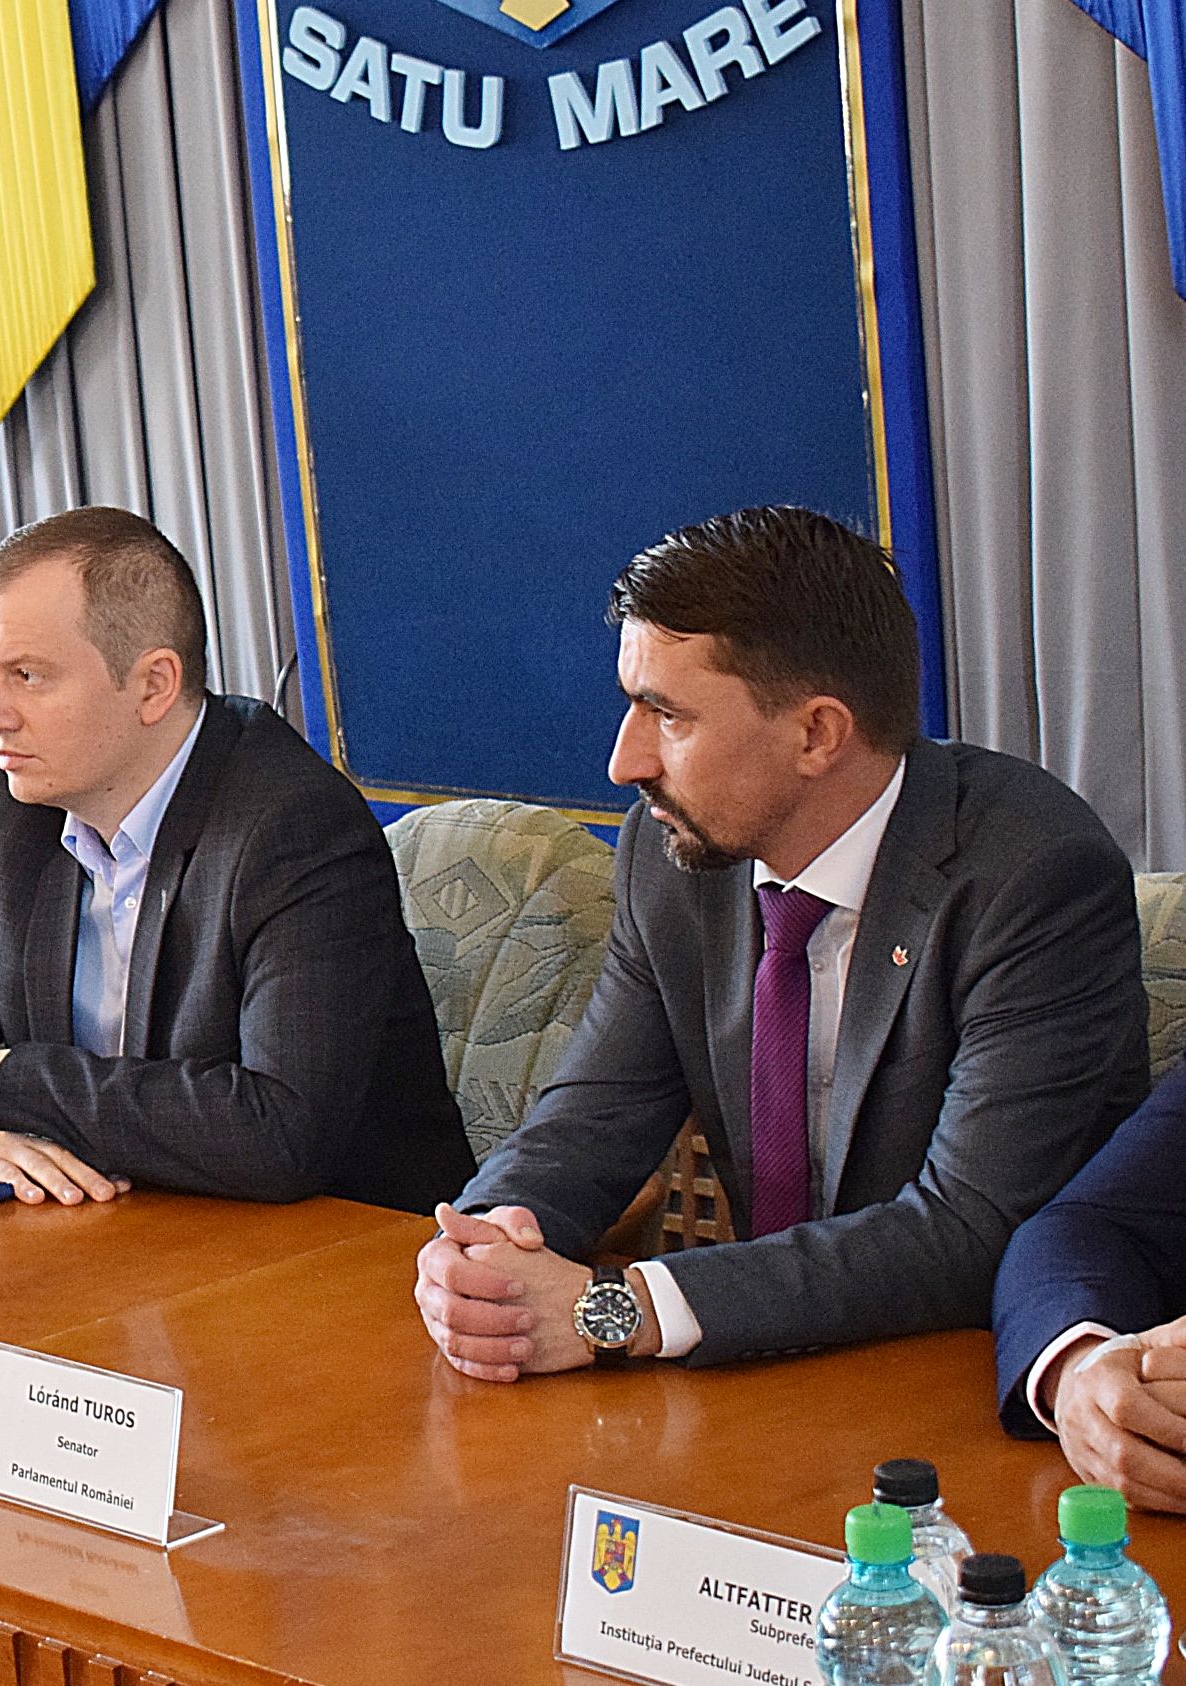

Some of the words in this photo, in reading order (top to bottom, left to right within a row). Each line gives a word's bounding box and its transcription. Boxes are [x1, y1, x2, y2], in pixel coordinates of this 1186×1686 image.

[283, 6, 505, 149] SATU
[548, 0, 821, 150] MARE
[28, 1384, 79, 1413] Lóránd
[83, 1399, 135, 1428] TUROS
[57, 1436, 98, 1457] Senator
[11, 1463, 78, 1493] Parlamentul
[81, 1482, 134, 1510] României
[699, 1577, 812, 1625] ALTFATTER
[750, 1619, 814, 1649] Subprefe
[667, 1640, 742, 1675] Prefectului
